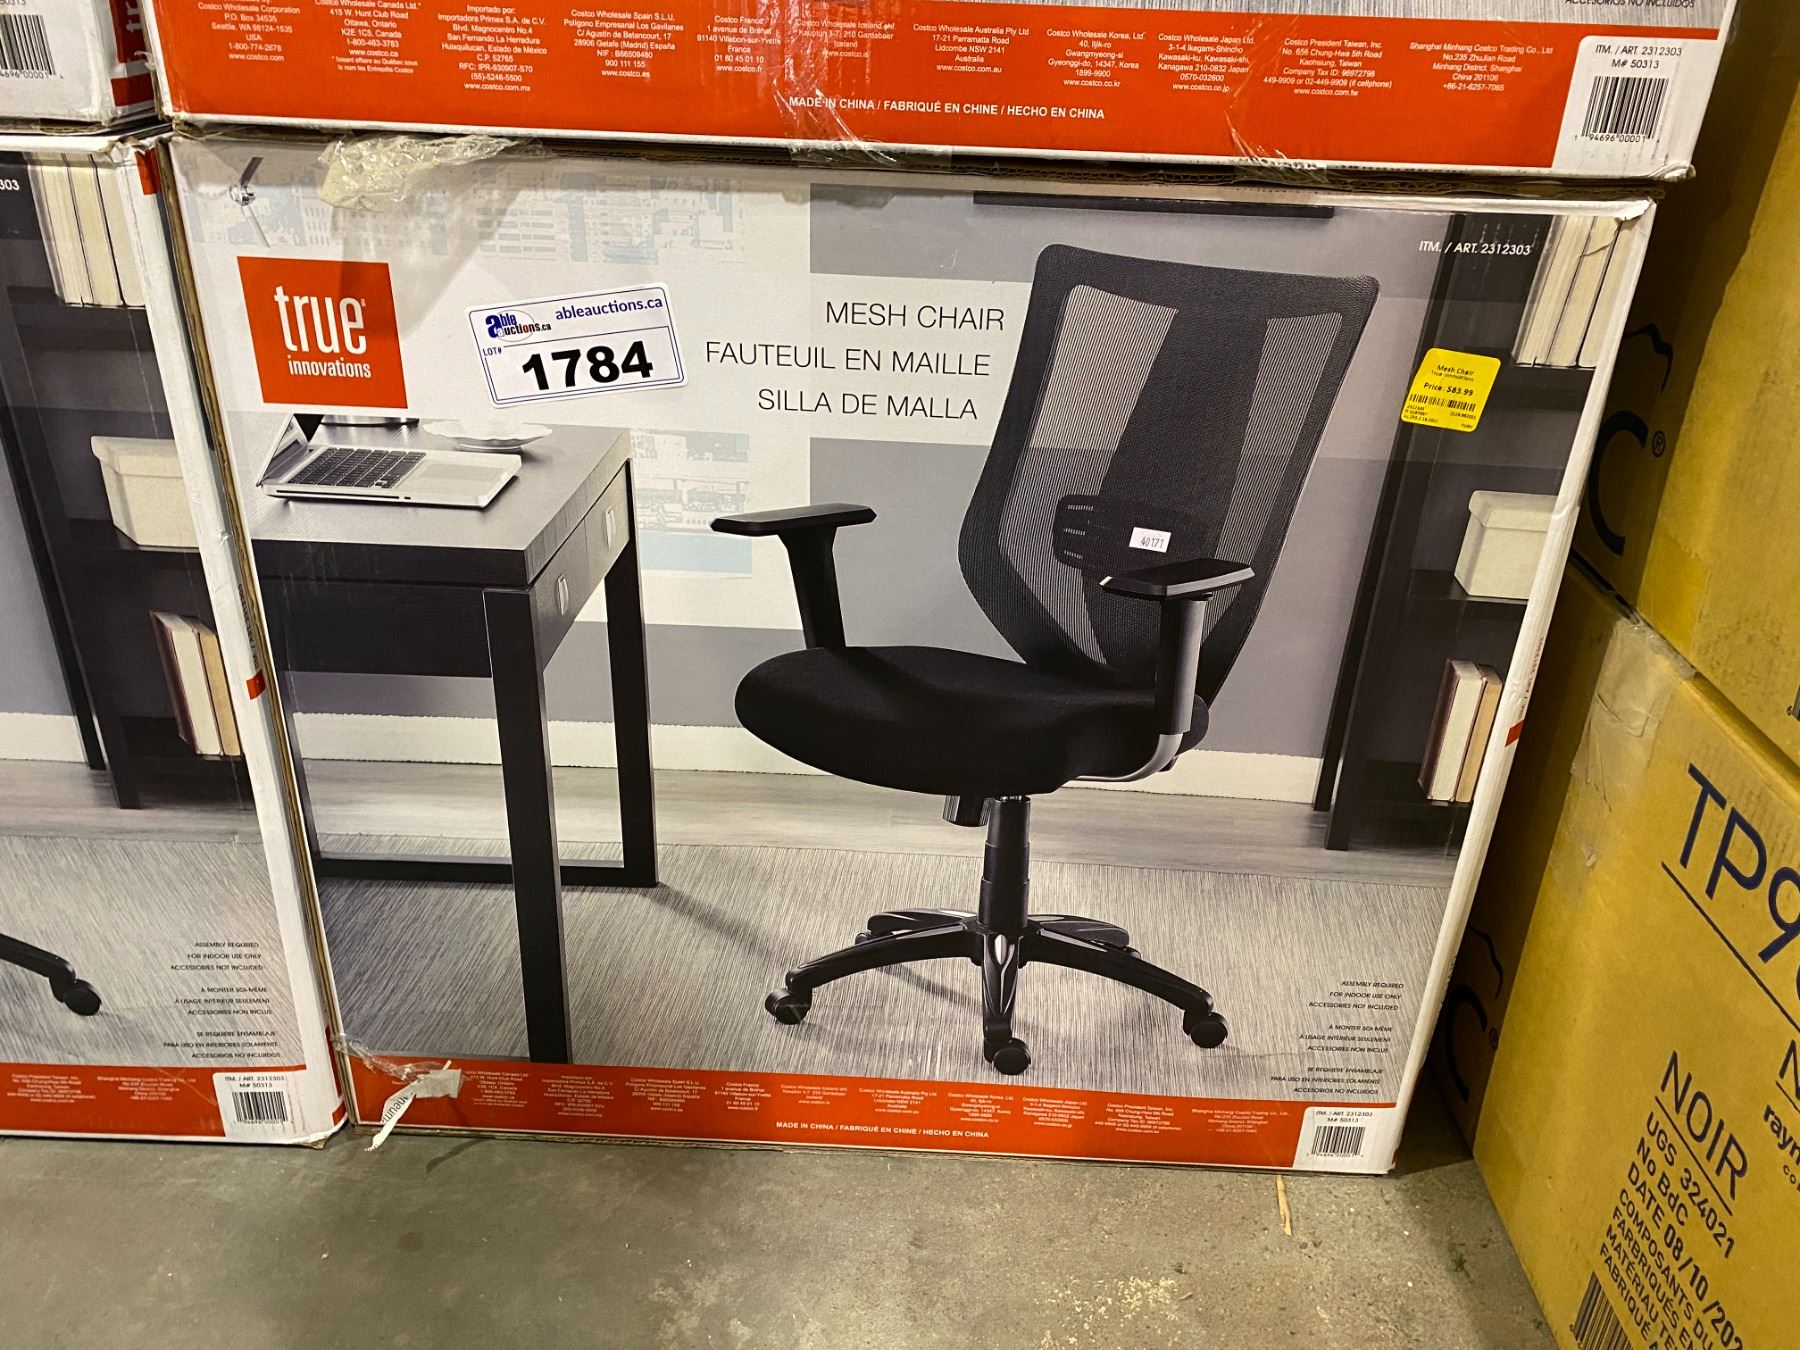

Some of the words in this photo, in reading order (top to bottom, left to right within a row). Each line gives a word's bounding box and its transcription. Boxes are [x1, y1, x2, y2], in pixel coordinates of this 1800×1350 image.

[198, 2, 223, 11] Costco
[223, 4, 260, 13] Wholesale
[261, 5, 300, 14] Corporation
[330, 8, 343, 16] 415
[373, 10, 390, 18] Club
[390, 11, 408, 19] Road
[467, 4, 500, 14] Importado
[571, 10, 596, 18] Costco
[596, 10, 632, 19] Wholesale
[633, 12, 653, 21] Spain
[714, 16, 738, 24] Costco
[740, 17, 764, 25] France
[371, 20, 397, 28] Ontario
[913, 24, 938, 32] Costco
[938, 24, 974, 34] Wholesale
[975, 26, 1004, 34] Australia
[932, 34, 951, 42] 17-21
[991, 36, 1010, 44] Road
[348, 48, 399, 57] www.costco.ca
[968, 45, 986, 54] NSW
[988, 46, 1005, 54] 2141
[1595, 45, 1613, 54] ITM.
[1622, 46, 1638, 56] ART.
[1642, 46, 1682, 56] 2312303
[228, 53, 284, 62] www.costco.com
[954, 54, 984, 63] Australia
[605, 60, 619, 68] 900
[620, 60, 632, 68] 111
[633, 60, 646, 68] 155
[716, 64, 762, 74] www.costco.fr
[936, 64, 1002, 73] www.costco.com.au
[1612, 59, 1627, 68] M#
[1630, 60, 1660, 69] 50313
[601, 69, 650, 78] www.costco.es
[464, 82, 530, 92] www.costco.com.mx
[1064, 78, 1120, 88] www.costco.co.kr
[1172, 84, 1230, 92] www.costco.co.jp
[1294, 88, 1358, 96] www.costco.com.tw
[789, 97, 822, 108] MADE
[824, 98, 836, 108] IN
[839, 99, 875, 110] CHINA
[884, 100, 942, 113] FABRIQUÉ
[944, 103, 960, 114] EN
[962, 104, 998, 115] CHINE
[1007, 105, 1048, 117] HECHO
[1050, 106, 1066, 117] EN
[1069, 108, 1105, 119] CHINA
[1589, 134, 1616, 142] 94696
[1620, 134, 1646, 143] 00001
[1419, 240, 1442, 252] ITM.
[1453, 242, 1478, 254] ART.
[1480, 244, 1531, 255] 2312303
[555, 298, 664, 321] ableauctions.ca
[274, 286, 367, 355] true
[826, 301, 906, 328] MESH
[917, 306, 1005, 331] CHAIR
[483, 346, 502, 356] LOT#
[706, 341, 836, 369] FAUTEUIL
[846, 348, 881, 371] EN
[892, 351, 991, 376] MAILLE
[287, 354, 372, 378] innovations
[522, 340, 654, 390] 1784
[1437, 364, 1456, 373] Mesh
[1456, 368, 1475, 376] Chair
[1446, 386, 1474, 396] $83.99
[758, 388, 832, 413] SILLA
[842, 394, 878, 415] DE
[888, 395, 978, 420] MALLA
[1140, 536, 1164, 549] 40171
[1680, 763, 1800, 1001] TP9
[1341, 980, 1372, 988] ASSEMBLY
[810, 1122, 834, 1130] CHINA
[922, 1128, 950, 1136] HECHO
[964, 1130, 990, 1138] CHINA
[1660, 1049, 1748, 1201] NOIR
[1636, 1136, 1656, 1177] No
[1656, 1172, 1689, 1227] BdC
[1646, 1111, 1677, 1166] UGS
[1680, 1167, 1734, 1258] 324021
[1627, 1162, 1665, 1230] DATE
[1619, 1188, 1695, 1322] COMPOSANTS
[1612, 1206, 1680, 1330] FARBRIQUÉS
[1606, 1224, 1659, 1324] MATÉRIAU
[1600, 1242, 1652, 1341] FABRIQUÉ
